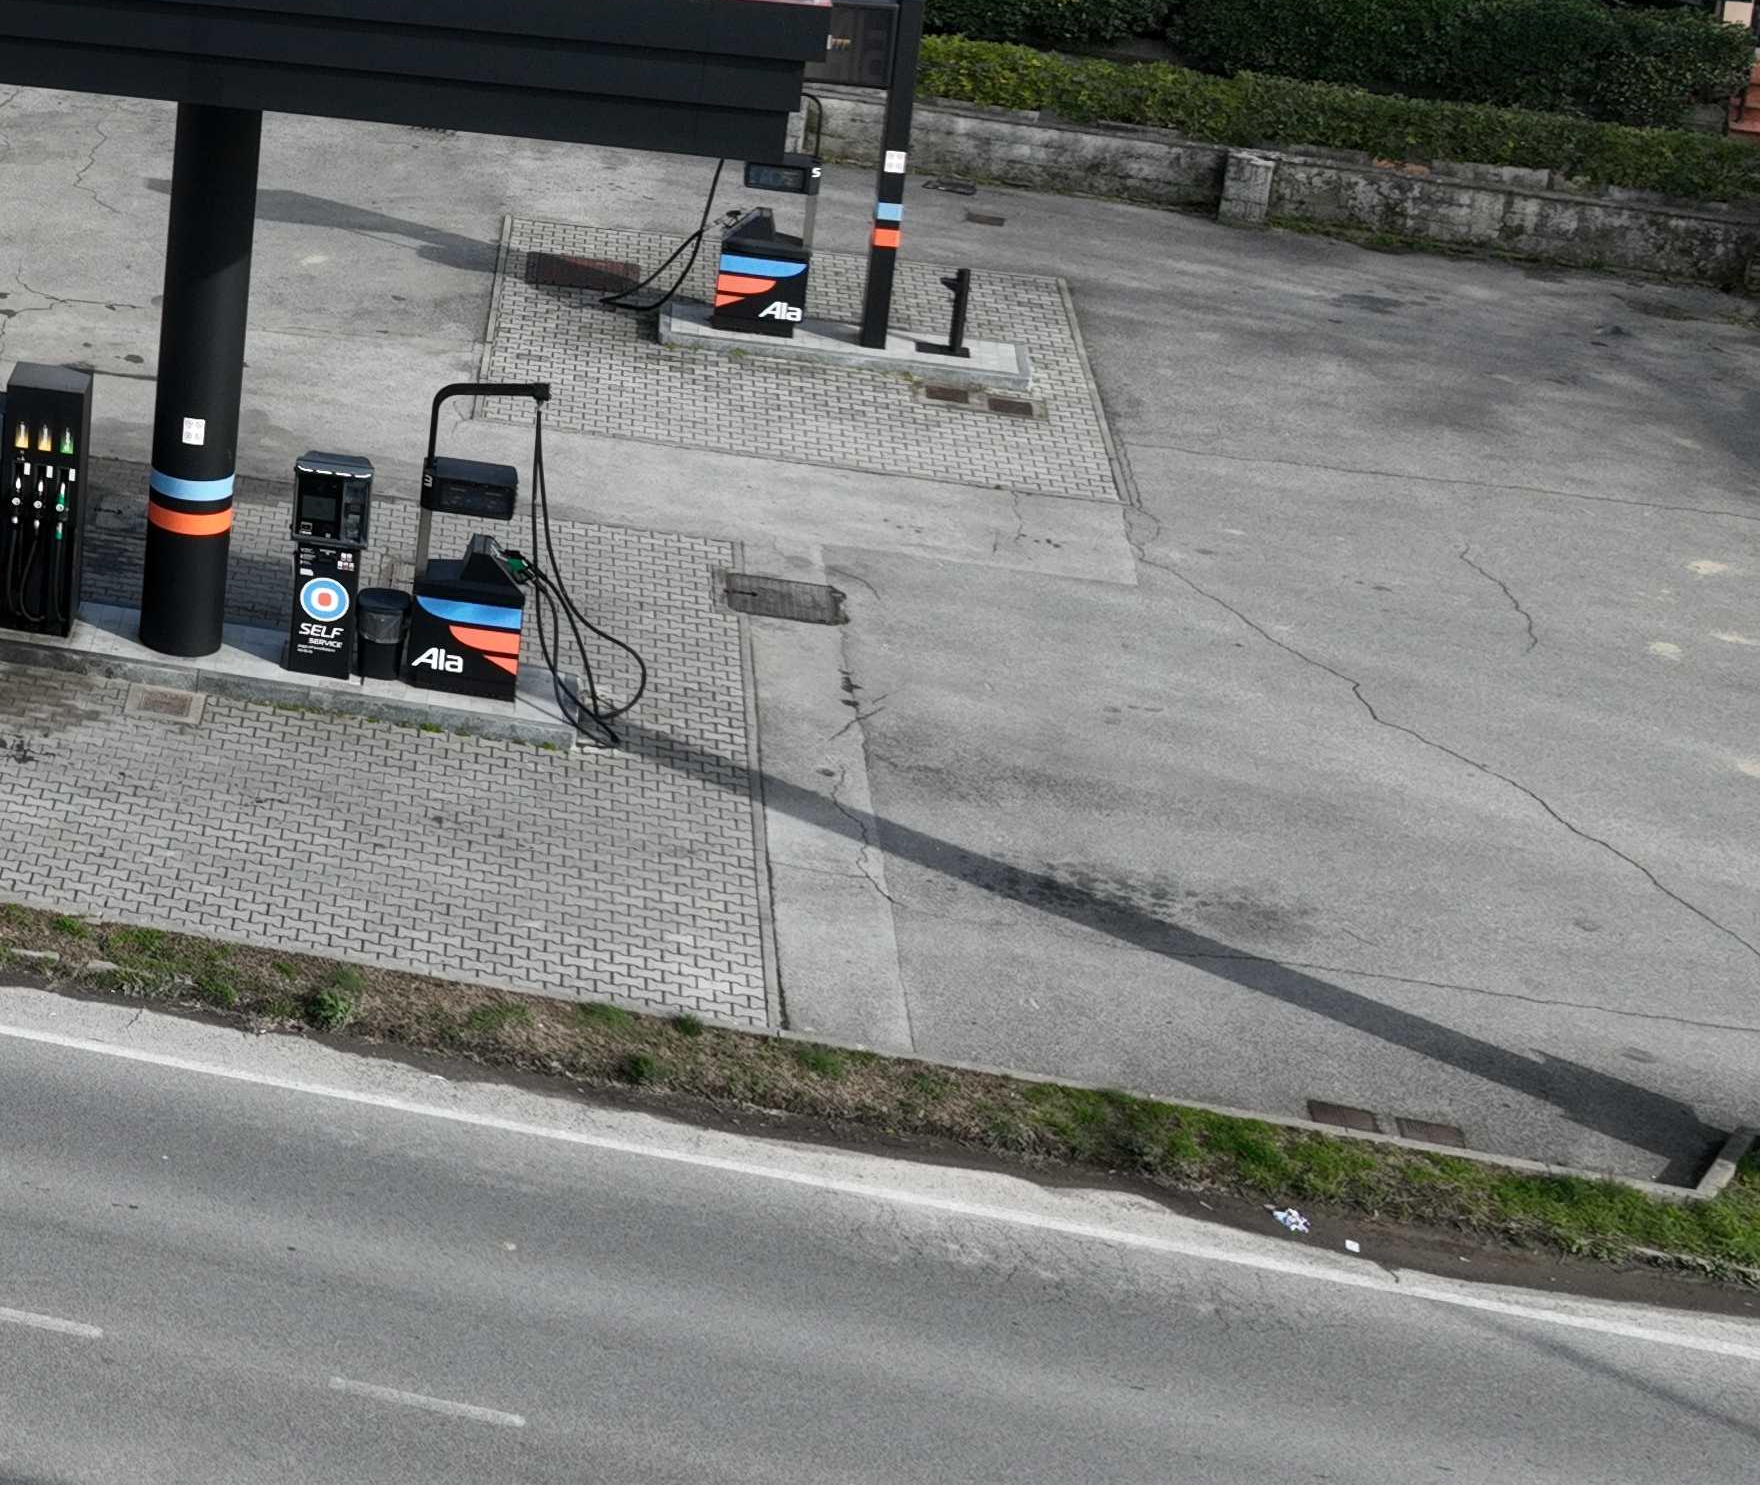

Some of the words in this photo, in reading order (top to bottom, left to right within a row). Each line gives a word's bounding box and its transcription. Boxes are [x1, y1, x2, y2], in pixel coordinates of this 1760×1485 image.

[758, 301, 803, 322] Ala
[298, 622, 345, 639] SELF
[308, 637, 344, 649] SERVICE
[411, 647, 464, 674] Ala
